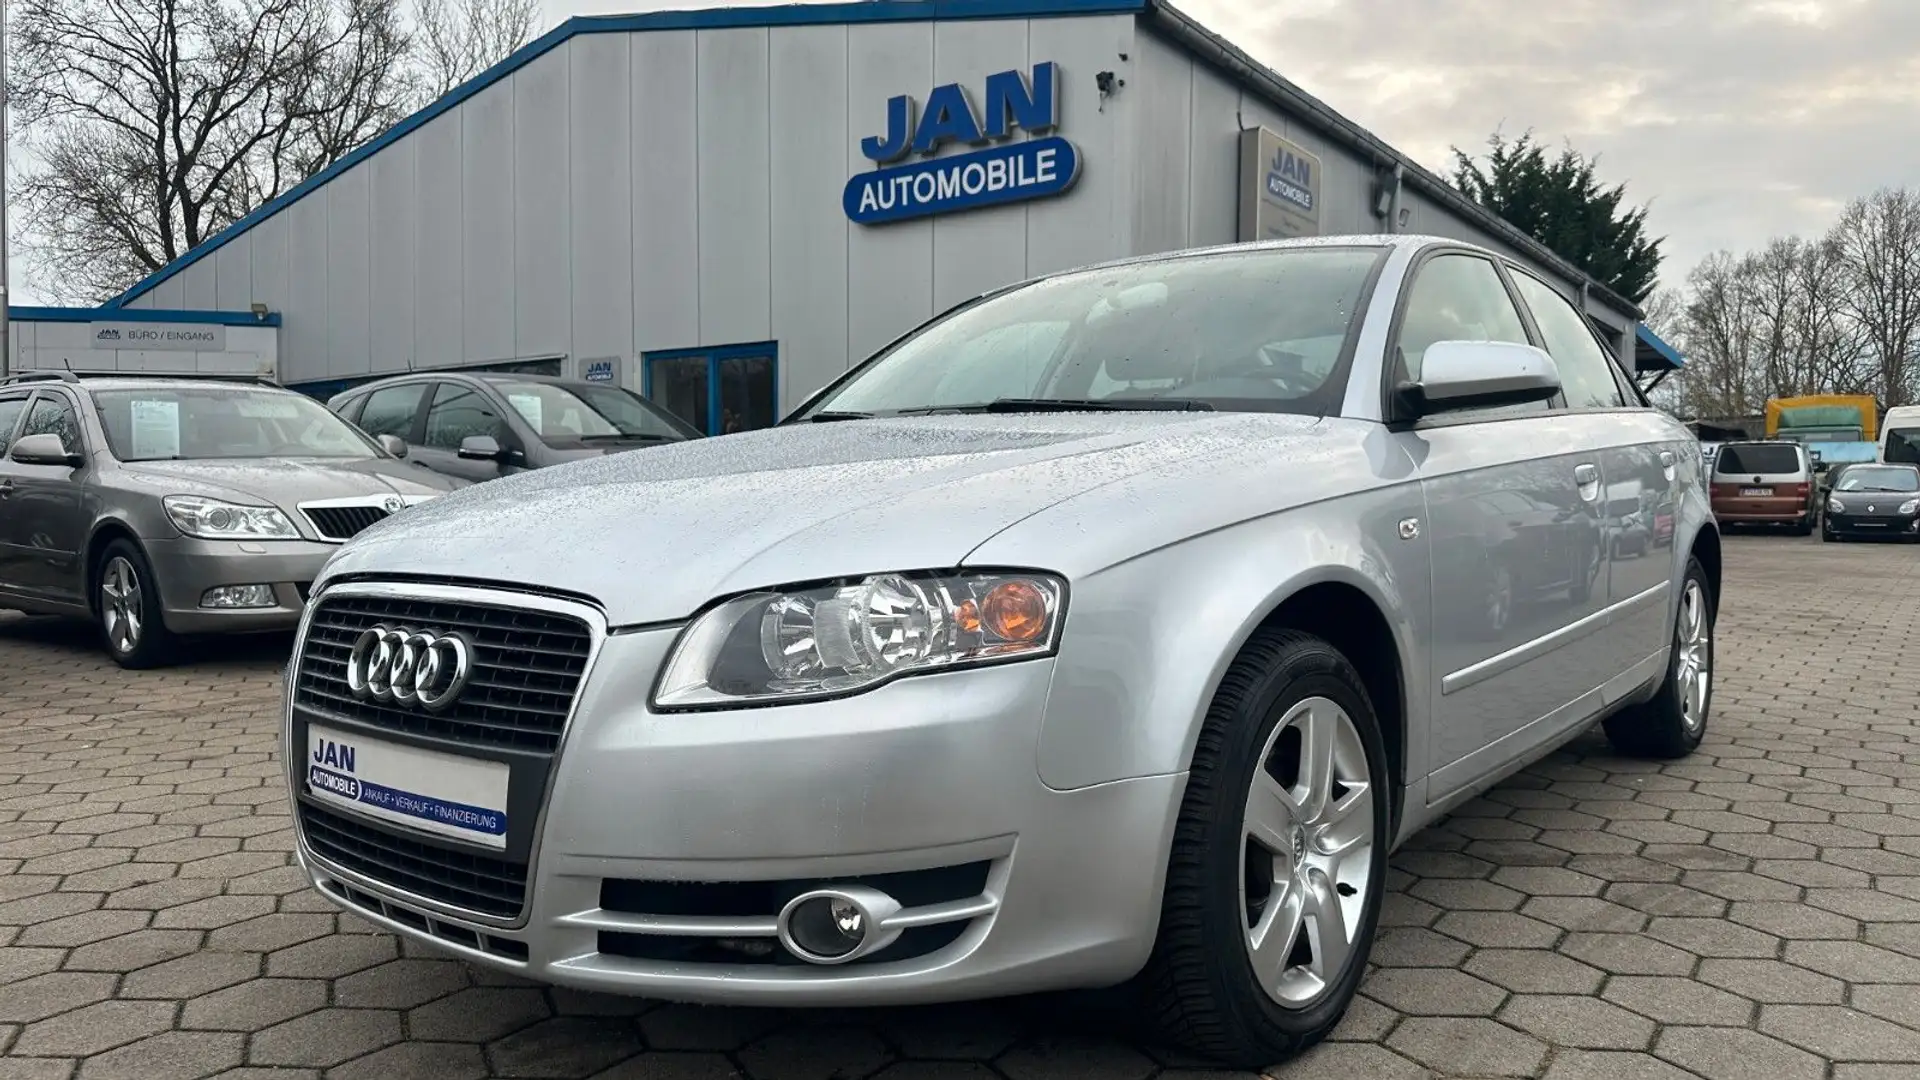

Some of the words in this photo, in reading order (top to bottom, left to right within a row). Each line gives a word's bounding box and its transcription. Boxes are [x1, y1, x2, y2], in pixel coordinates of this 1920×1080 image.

[861, 61, 1056, 161] JAN
[859, 149, 1057, 213] AUTOMOBILE
[1272, 146, 1310, 187] JAN
[1269, 177, 1311, 208] AUTOMOBILE
[128, 330, 157, 340] BÜRO
[167, 332, 214, 340] EINGANG
[588, 361, 611, 373] JAN
[313, 738, 356, 773] JAN
[312, 771, 356, 796] AUTOMOBILE
[364, 788, 390, 803] ANKAUF
[395, 795, 429, 814] VERKAUF
[435, 805, 496, 829] FINANZIERUNG
